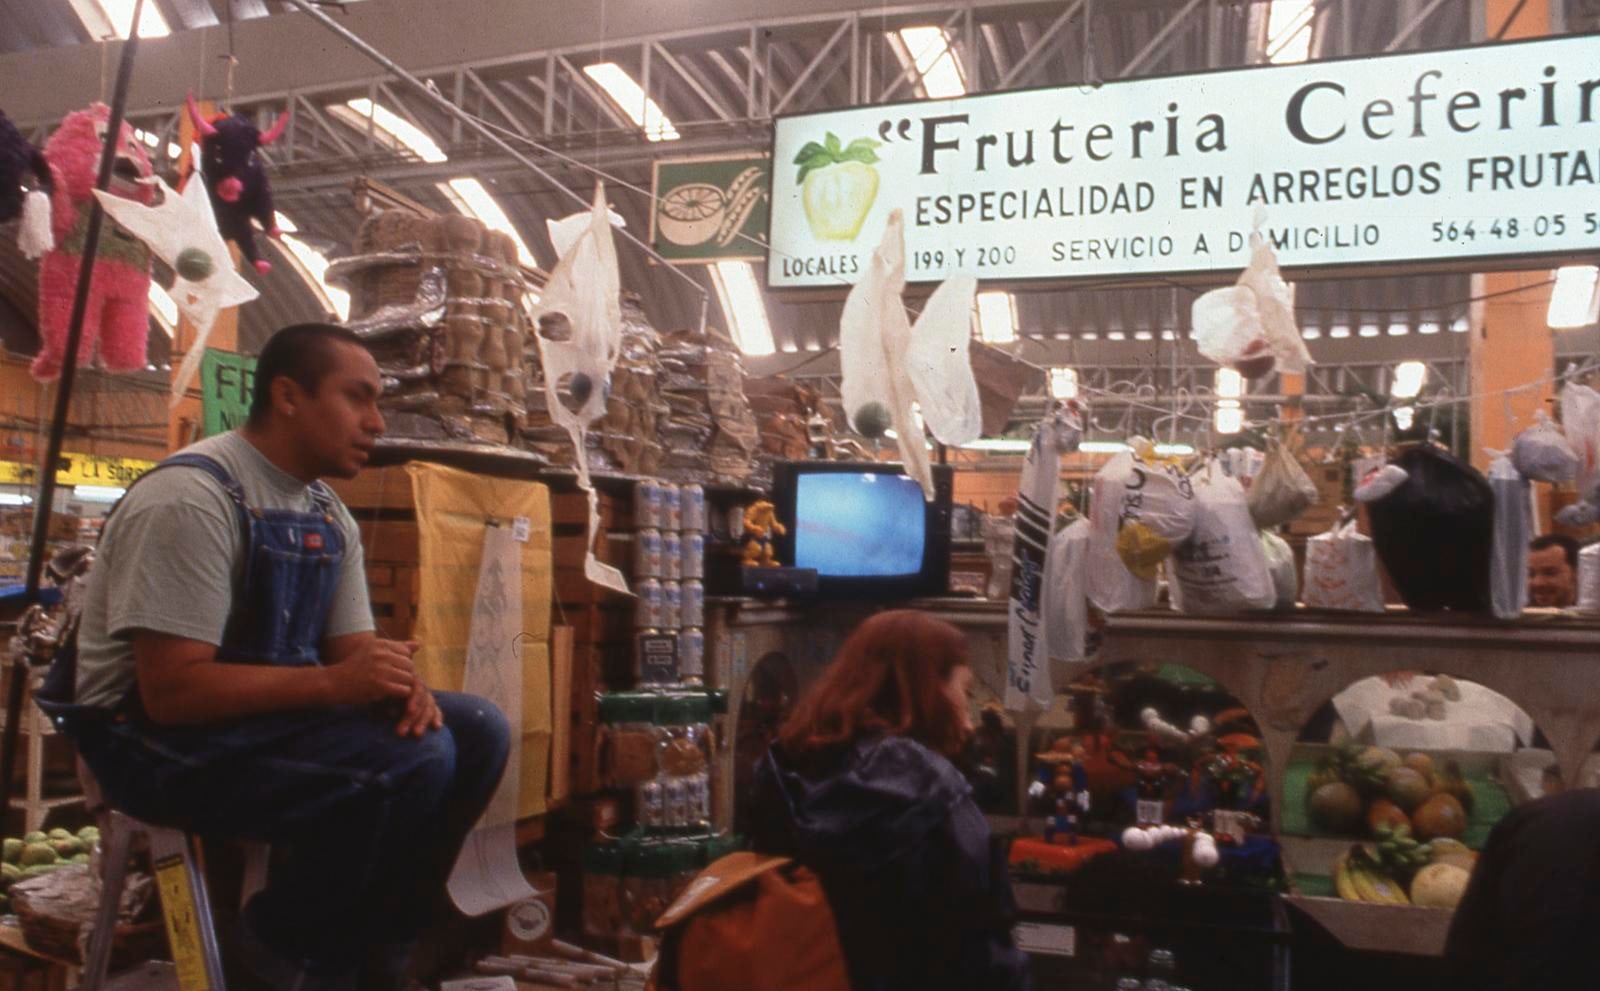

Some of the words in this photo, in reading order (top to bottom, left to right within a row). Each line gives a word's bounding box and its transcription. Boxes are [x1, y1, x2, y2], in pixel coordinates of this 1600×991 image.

[915, 181, 1156, 227] ESPECIALIDAD
[1181, 176, 1223, 210] EN
[1246, 161, 1442, 207] ARREGLOS
[1468, 149, 1600, 193] FRUTA
[782, 253, 859, 278] LOCALES
[914, 250, 944, 270] 199
[955, 247, 966, 268] Y
[977, 245, 1016, 267] 200
[1051, 235, 1173, 262] SERVICIO
[1193, 232, 1210, 255] A
